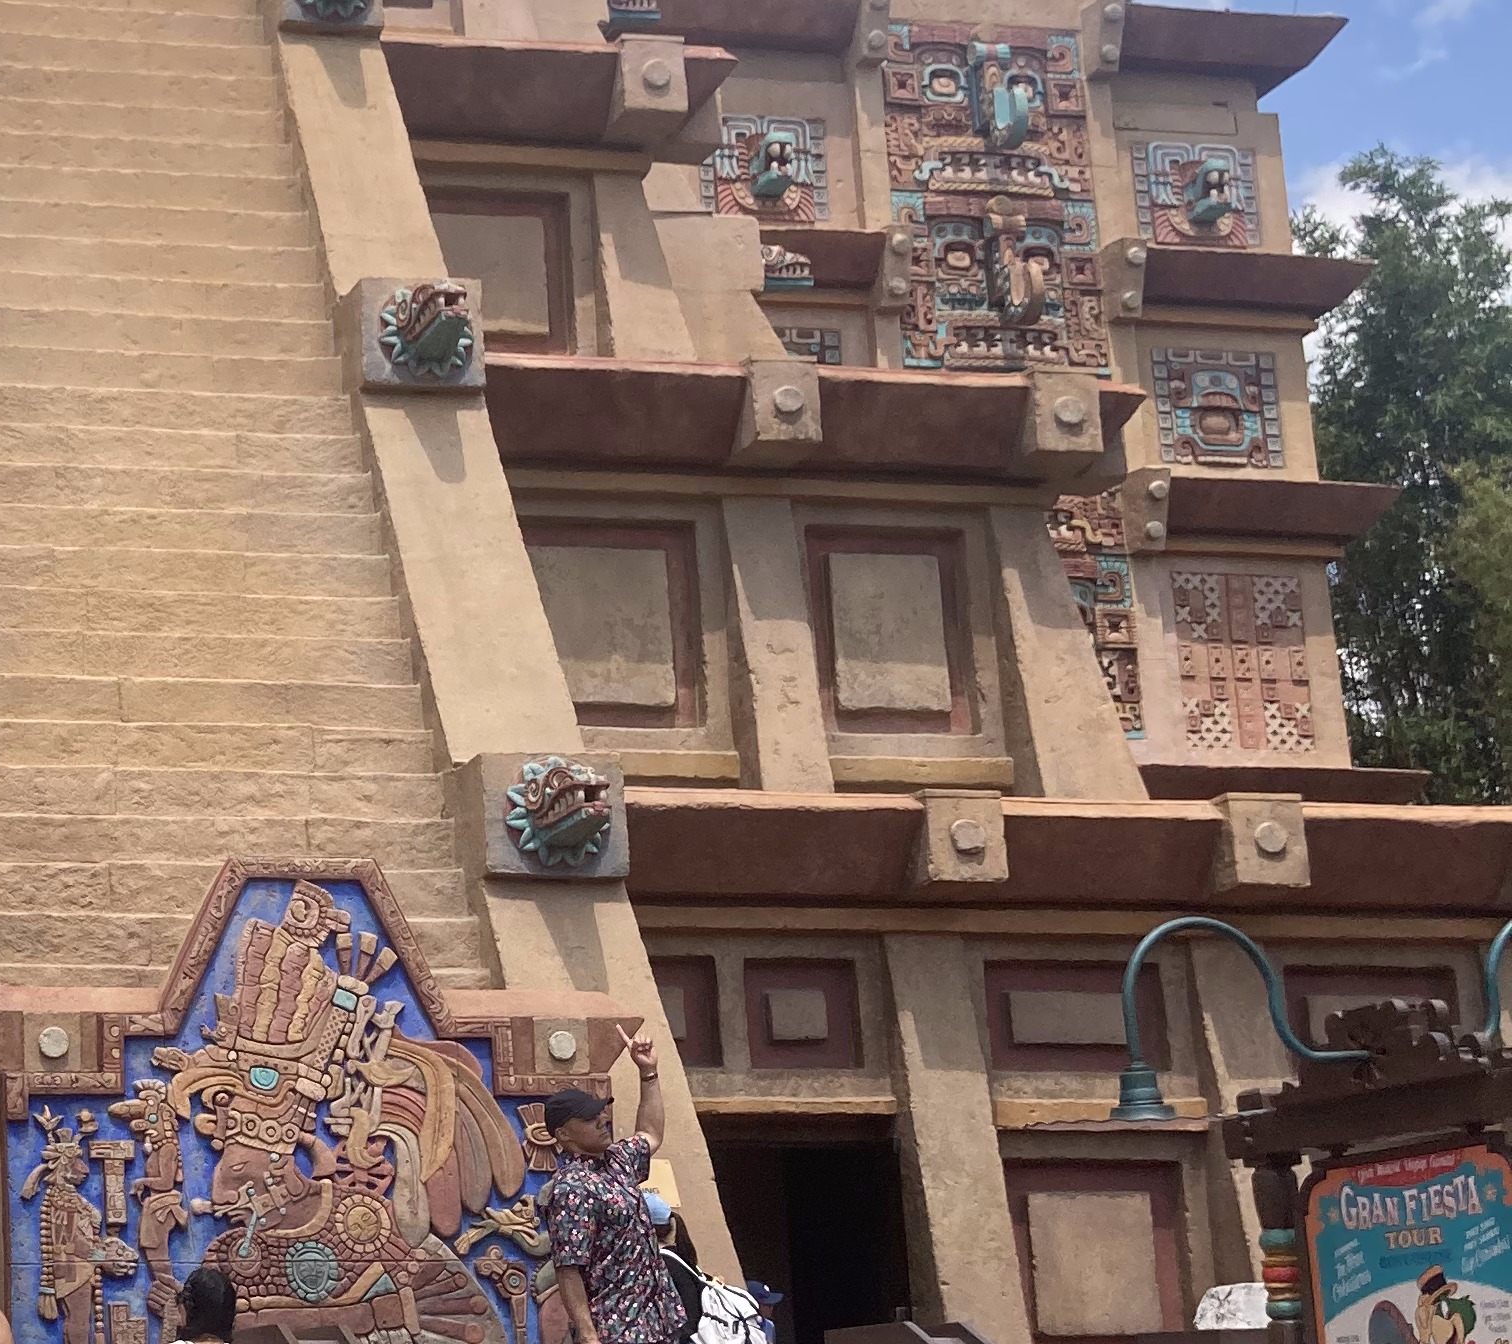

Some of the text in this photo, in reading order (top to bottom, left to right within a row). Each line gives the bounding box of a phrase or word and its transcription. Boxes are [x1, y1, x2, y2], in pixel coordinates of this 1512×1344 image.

[1340, 1174, 1483, 1230] GRAN FIESTA
[1384, 1226, 1444, 1250] TOUR
